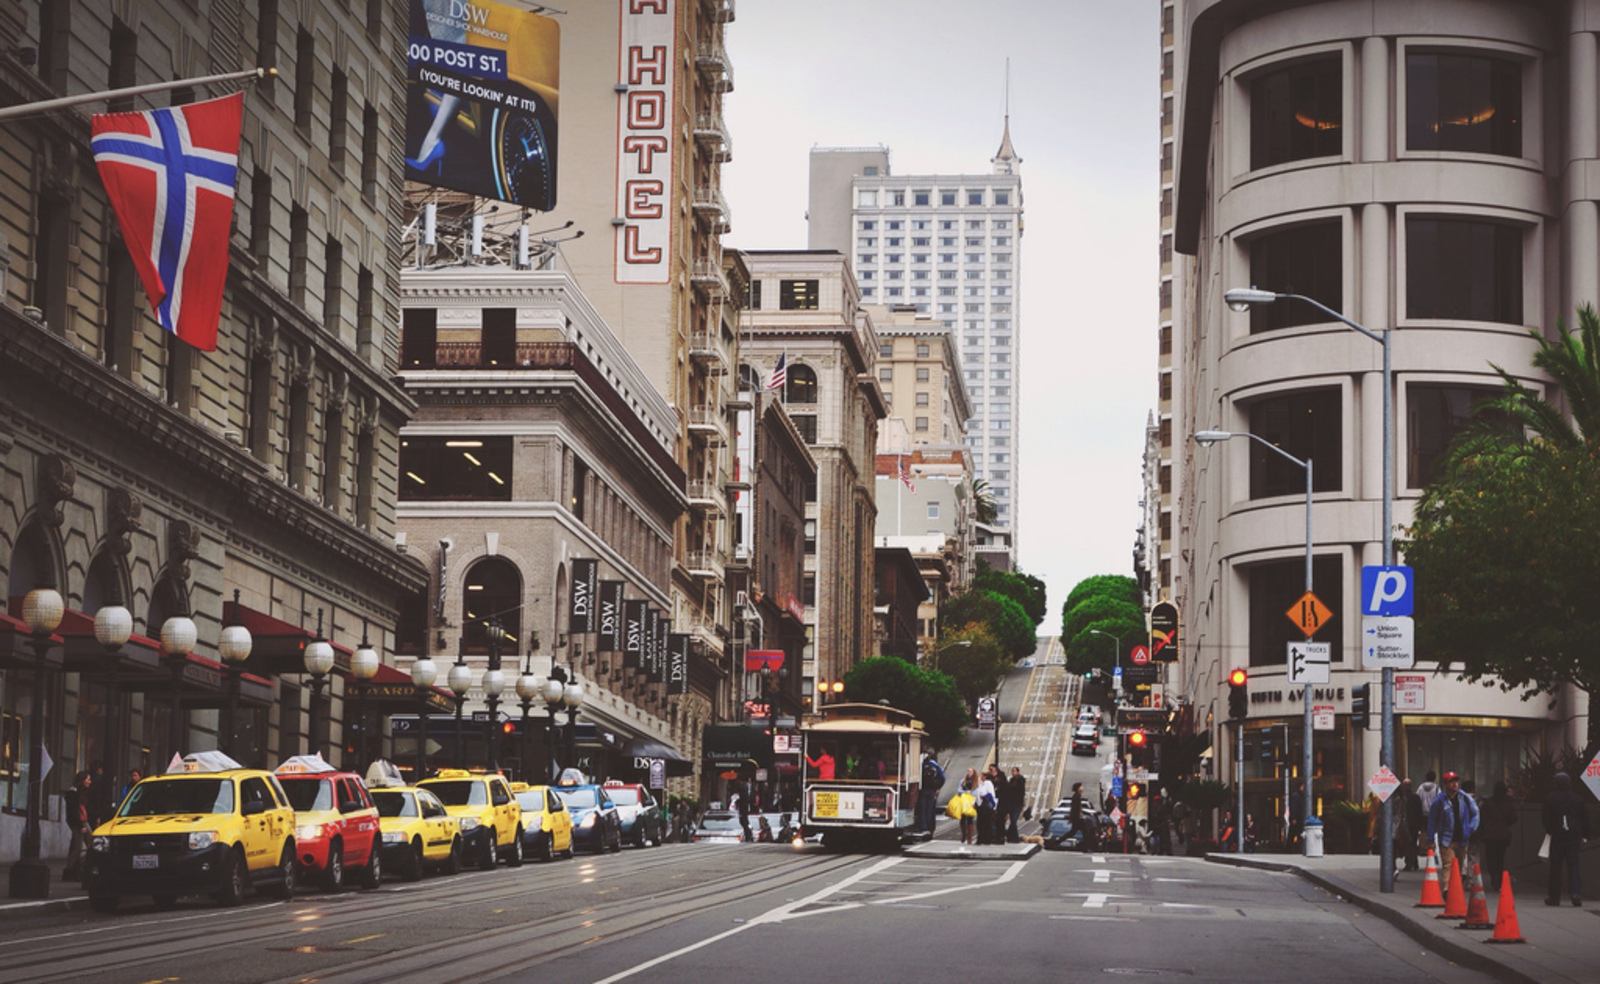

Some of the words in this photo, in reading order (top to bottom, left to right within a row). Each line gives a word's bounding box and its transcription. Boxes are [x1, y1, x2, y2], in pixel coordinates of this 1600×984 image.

[449, 0, 490, 25] DSW
[406, 43, 430, 61] 00
[434, 47, 476, 69] POST
[479, 55, 502, 73] ST.
[419, 68, 461, 91] (YOU'RE
[463, 81, 504, 103] LOOKIN'
[505, 94, 519, 108] AT
[624, 46, 667, 264] HOTEL
[574, 580, 588, 616] DSW
[601, 601, 615, 635] DSW
[627, 619, 640, 651] DSW
[1306, 646, 1327, 654] TRUCKS
[1377, 632, 1403, 640] Square
[671, 651, 682, 681] DSW
[1377, 652, 1410, 660] Stockton
[1288, 688, 1345, 703] AVNUE
